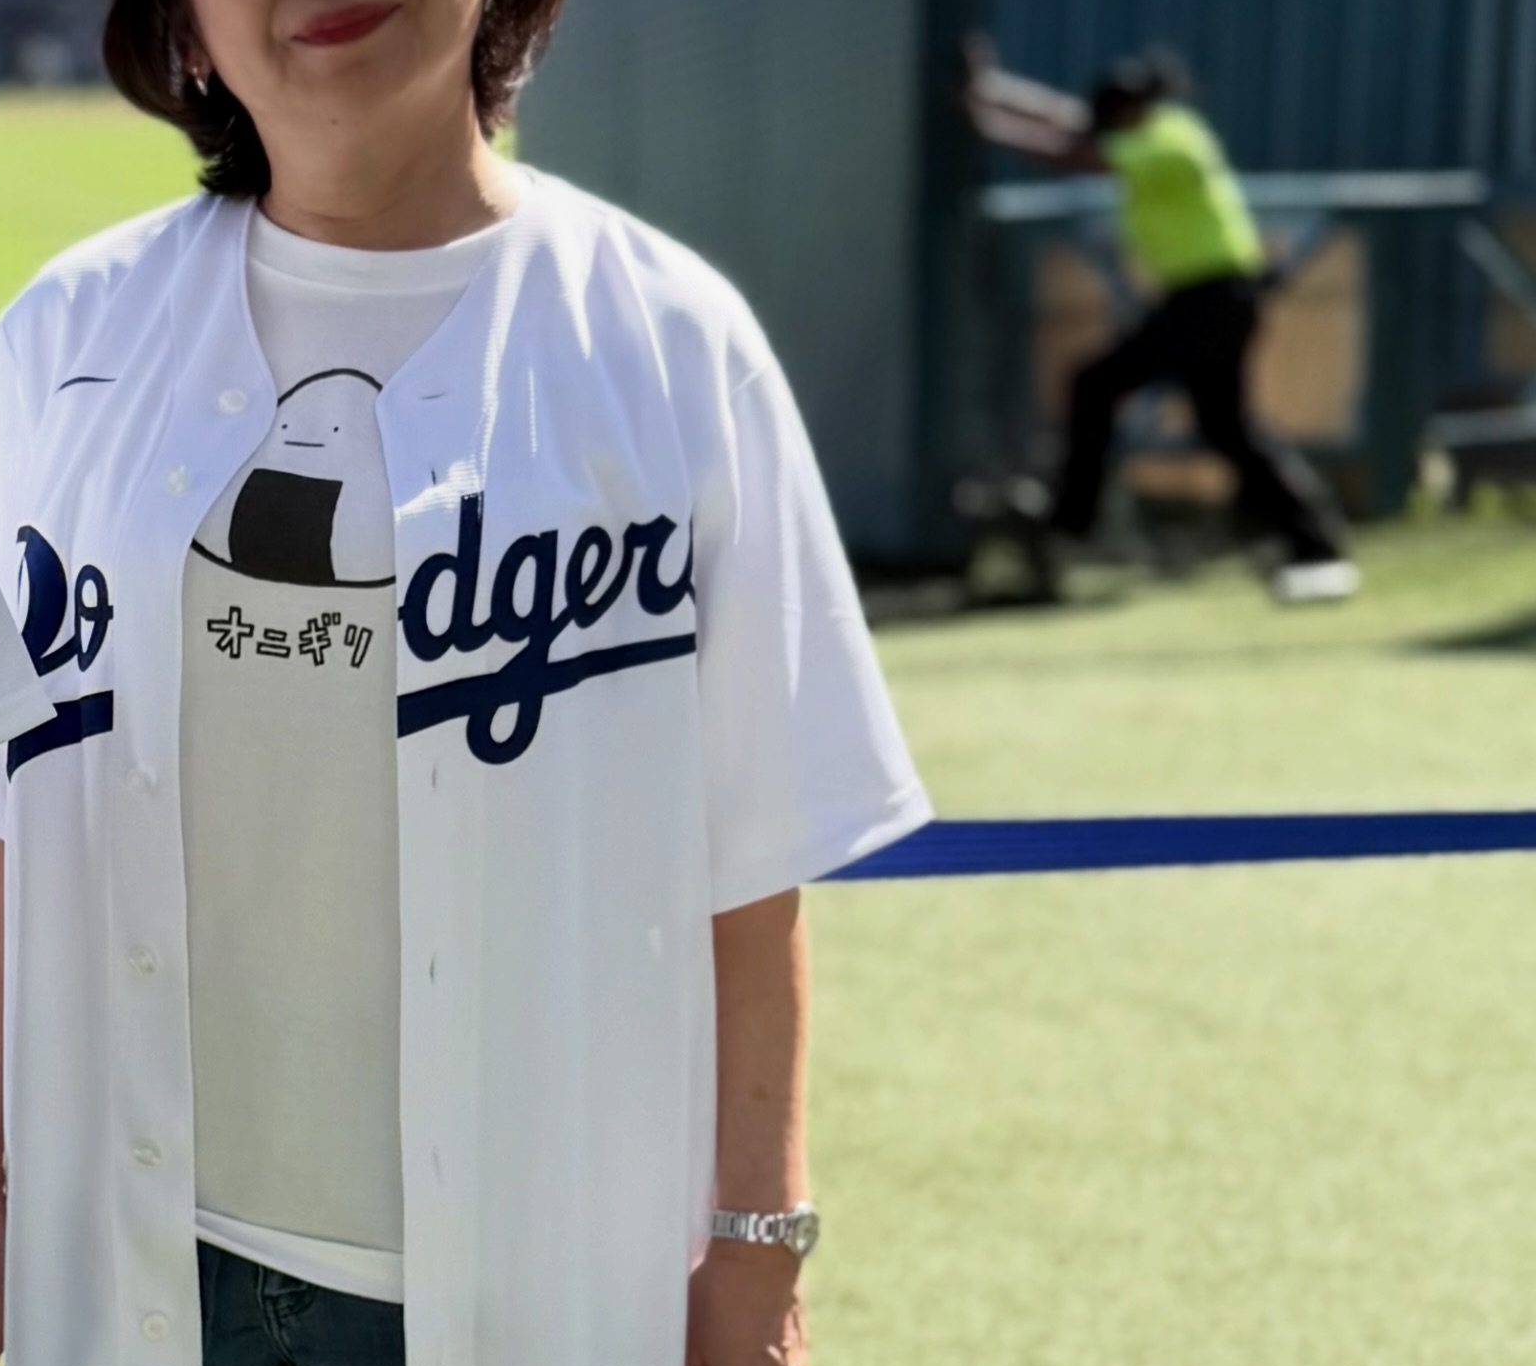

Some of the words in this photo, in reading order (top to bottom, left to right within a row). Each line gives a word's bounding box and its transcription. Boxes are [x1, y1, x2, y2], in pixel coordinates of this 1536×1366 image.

[206, 605, 374, 669] オニギリ
[396, 490, 696, 765] dger
